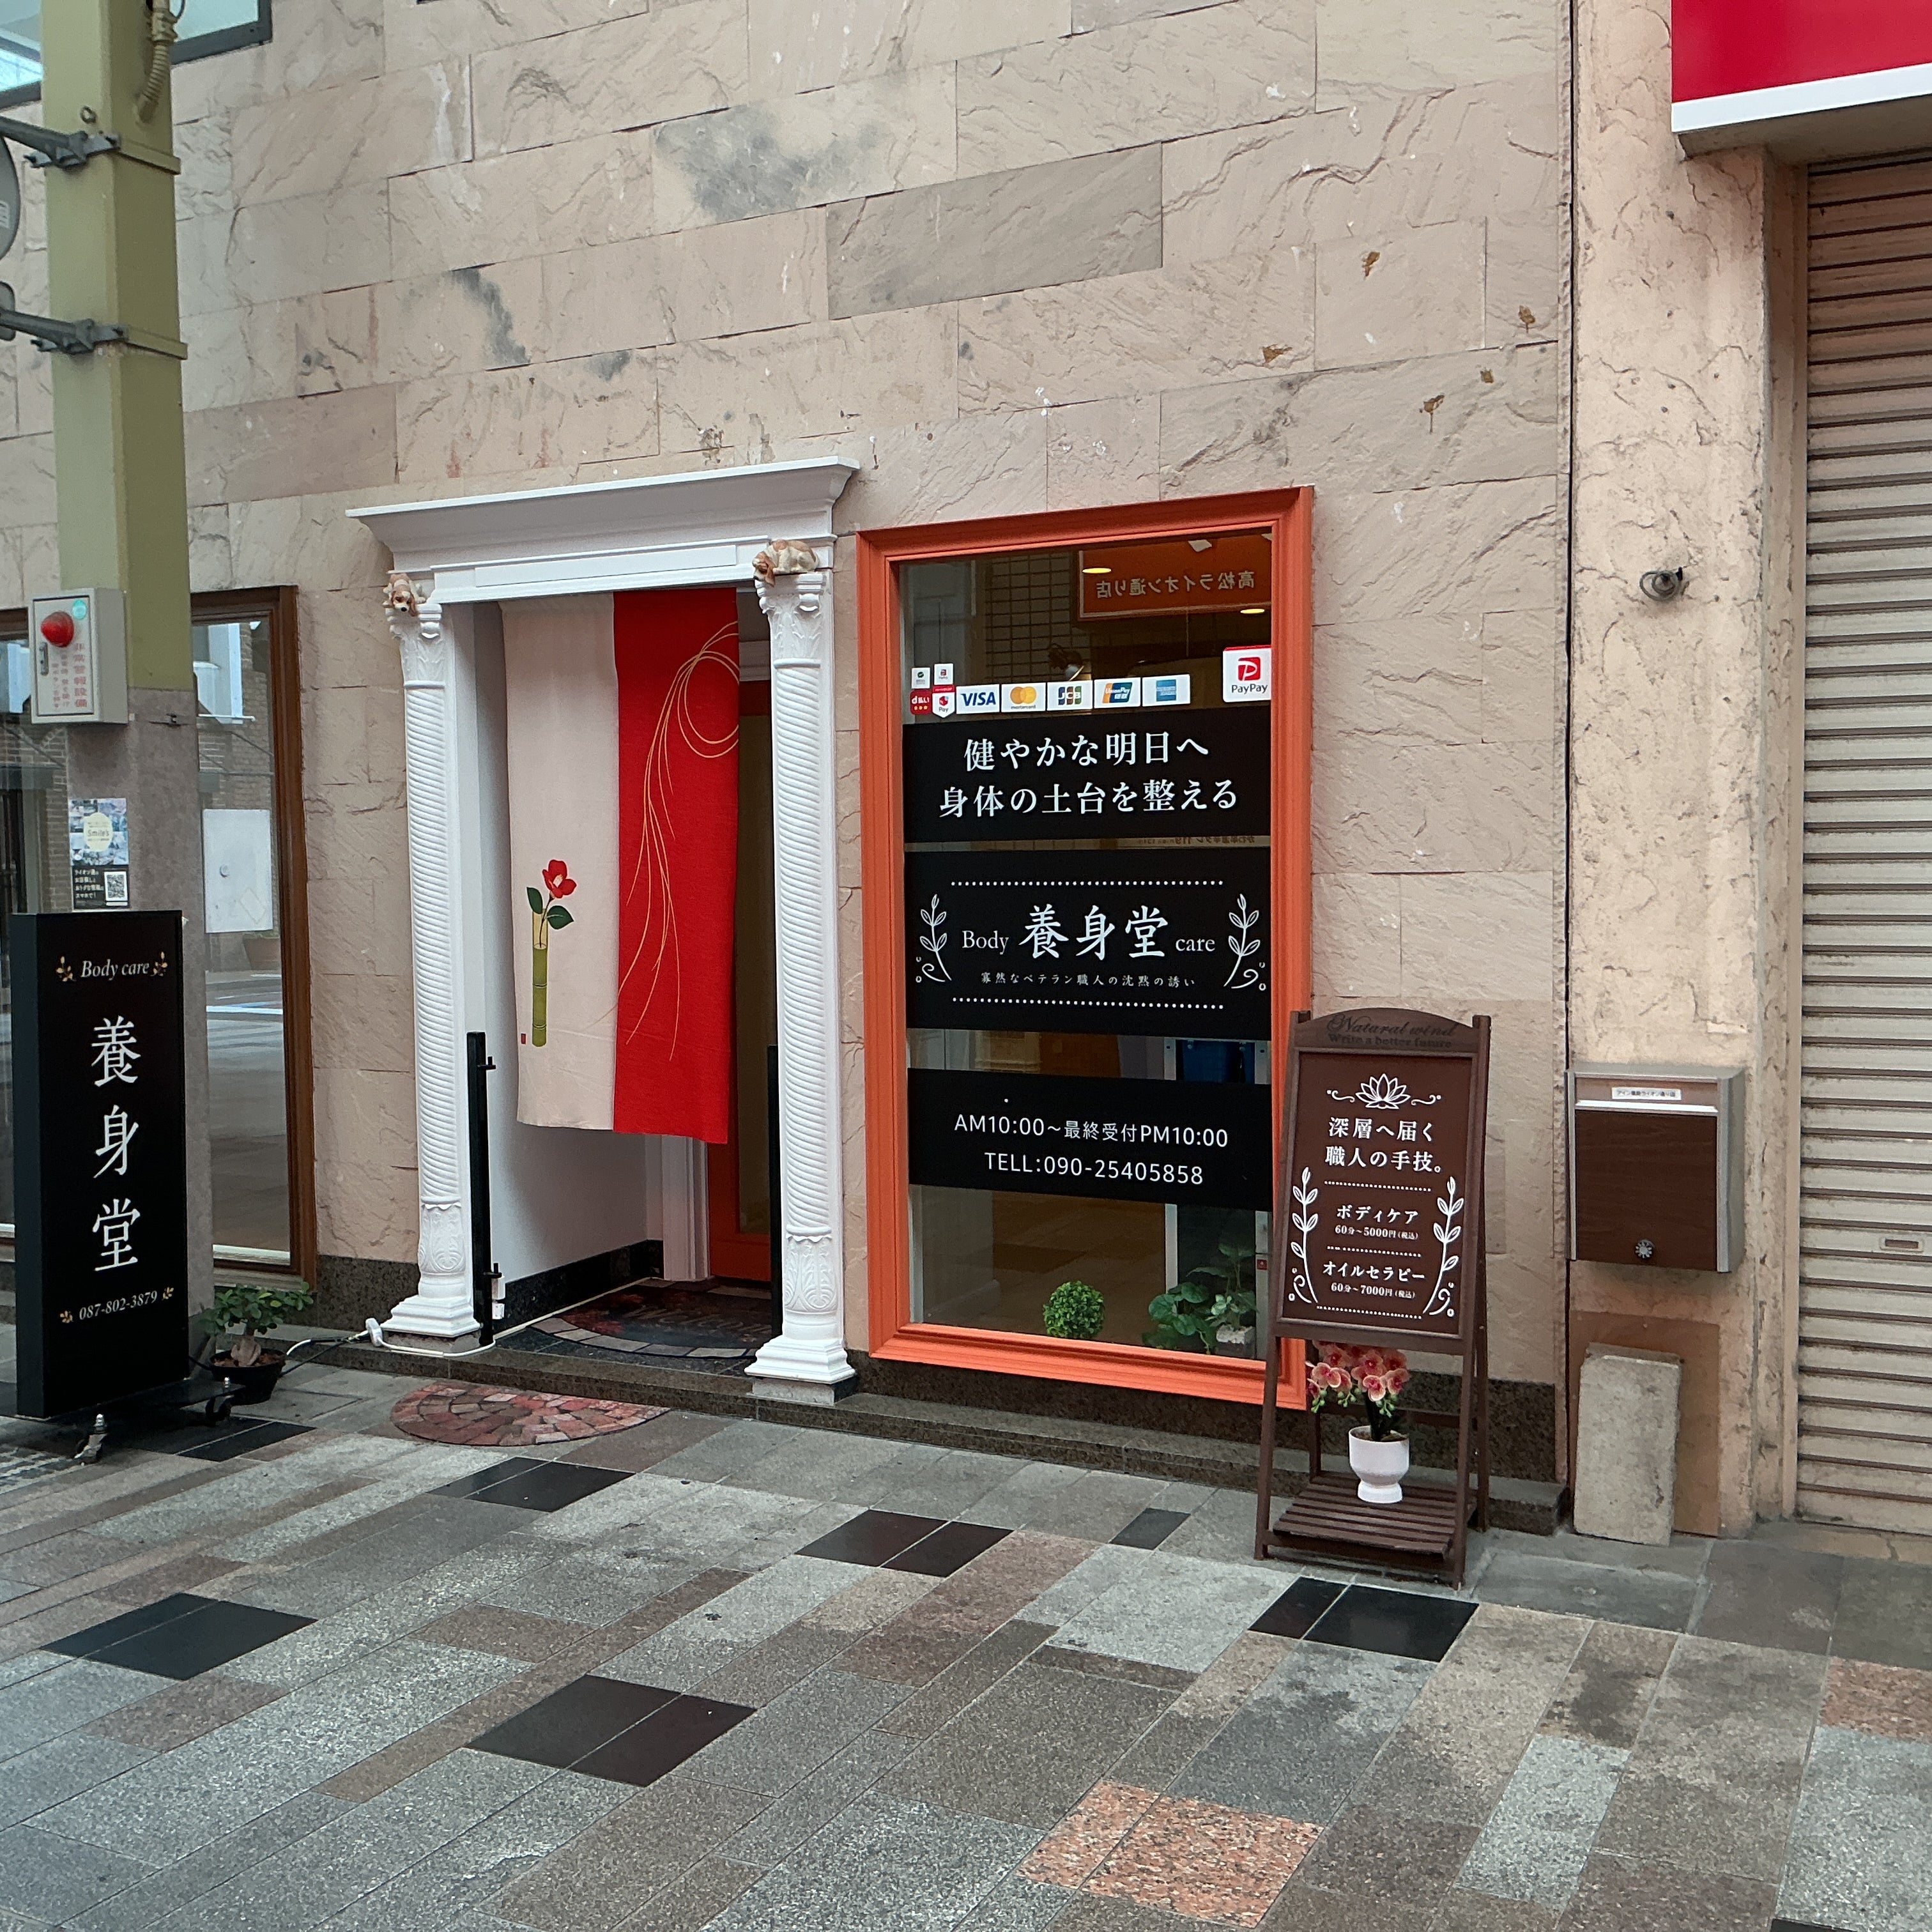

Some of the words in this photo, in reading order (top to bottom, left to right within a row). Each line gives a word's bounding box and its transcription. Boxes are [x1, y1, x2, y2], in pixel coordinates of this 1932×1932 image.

[961, 692, 997, 707] VISA
[1231, 683, 1268, 695] PayPay
[963, 731, 1209, 772] 健やかな明日へ
[939, 779, 1237, 818] 身体の土台を整える
[962, 930, 1009, 955] Body
[1018, 903, 1169, 961] 養身堂
[1176, 939, 1215, 953] care
[80, 958, 118, 981] Body
[121, 963, 150, 976] care
[1409, 1022, 1458, 1036] wind
[1328, 1117, 1433, 1142] 深層へ届く
[91, 1015, 141, 1272] 養身堂
[984, 1152, 1204, 1185] TELL:090-25405858
[1324, 1146, 1441, 1173] 職人の手技。
[1336, 1204, 1419, 1225] ボディケア
[1322, 1261, 1425, 1282] オイルセラピー
[79, 1291, 158, 1321] 087-802-3879
